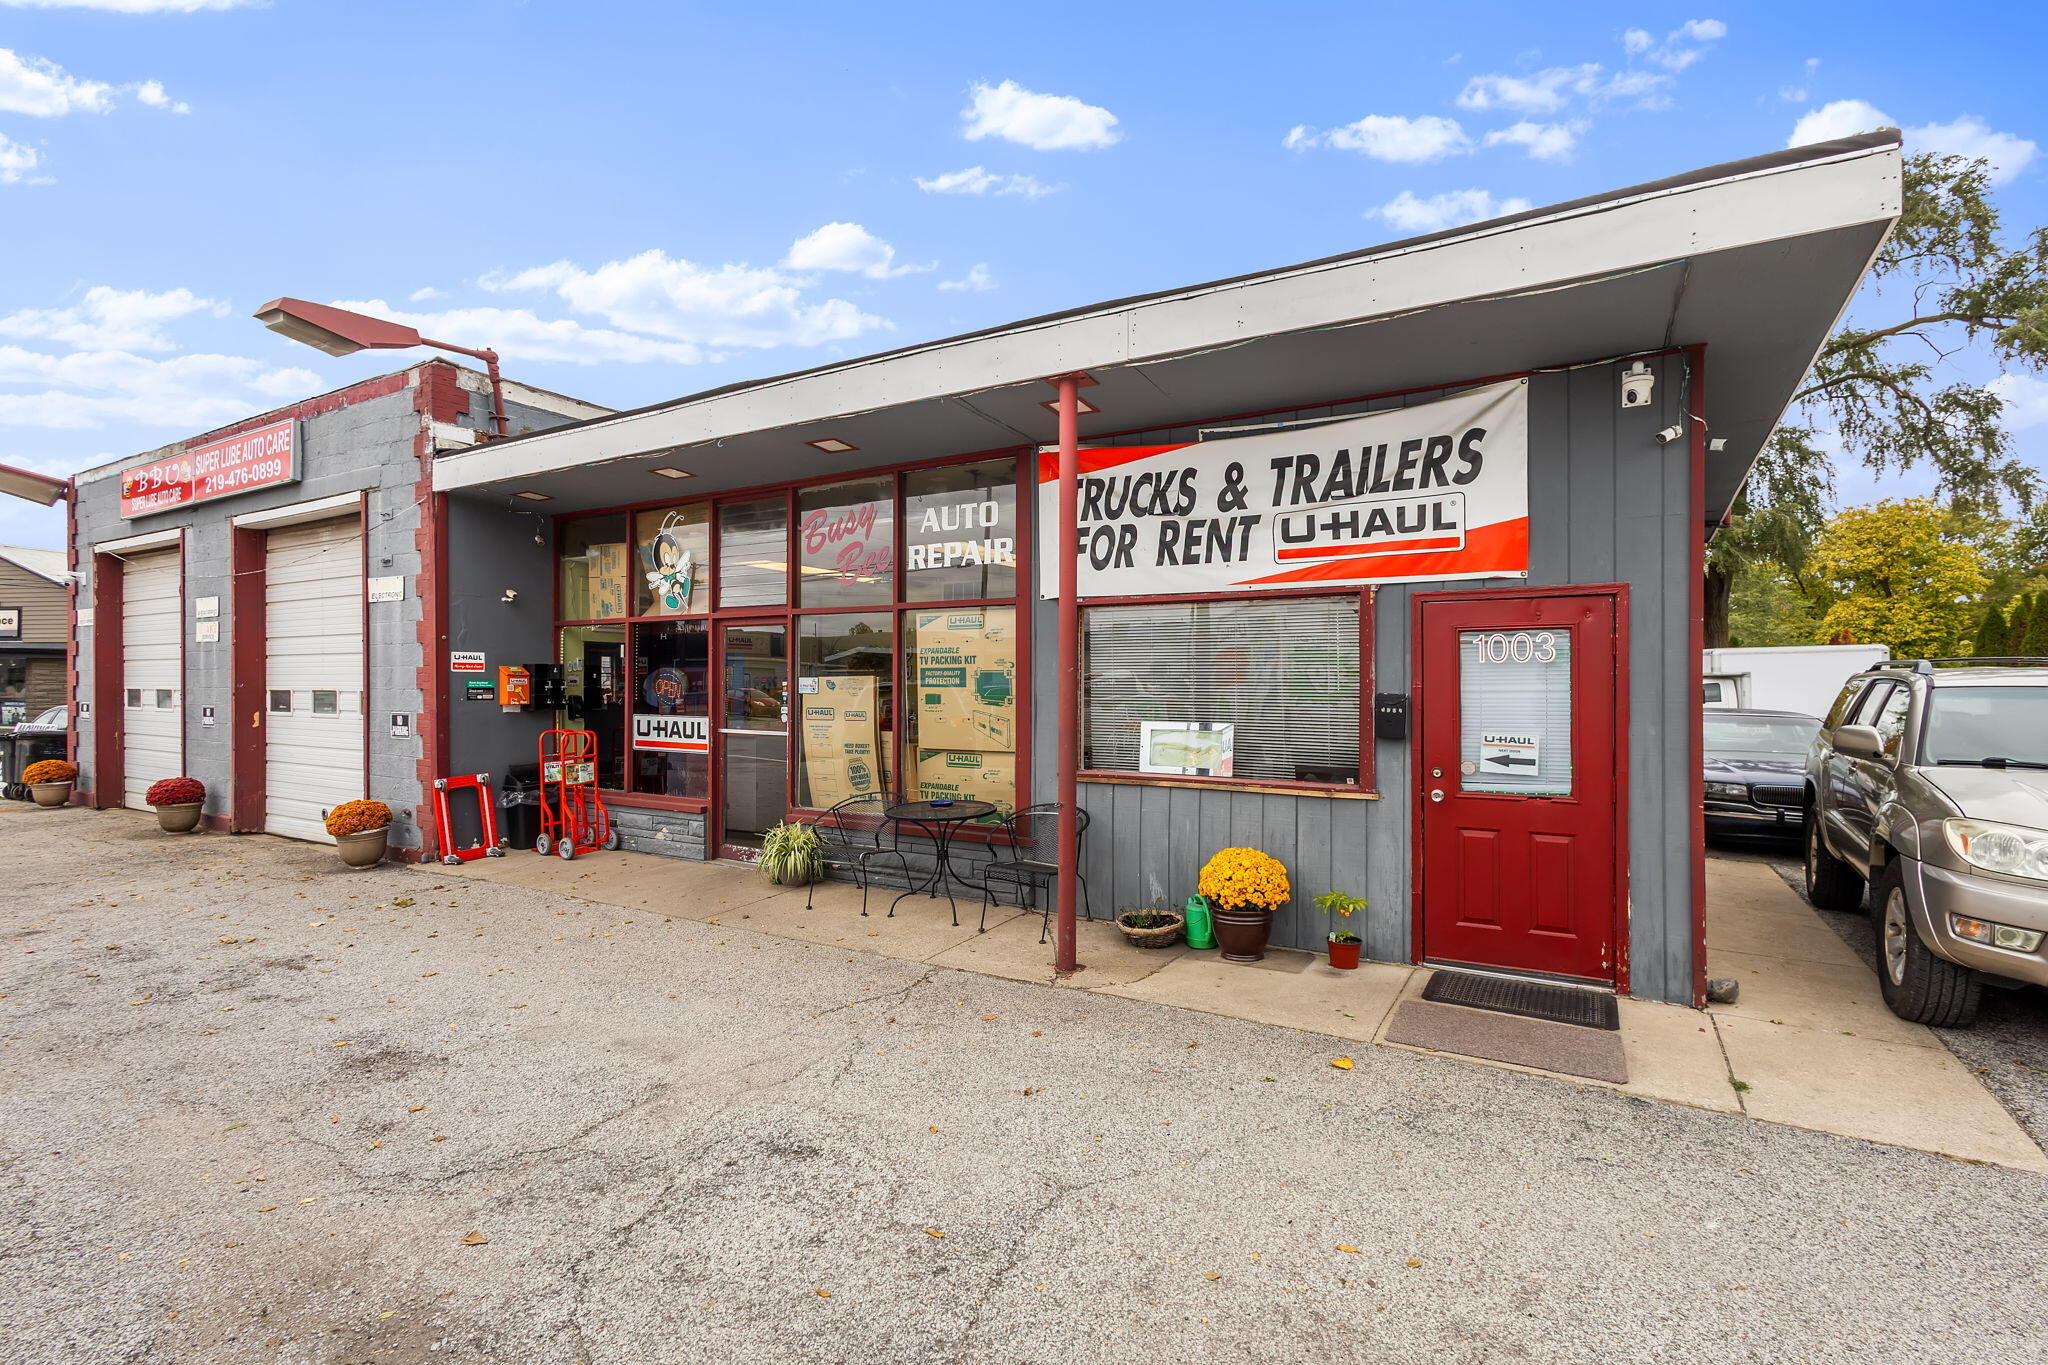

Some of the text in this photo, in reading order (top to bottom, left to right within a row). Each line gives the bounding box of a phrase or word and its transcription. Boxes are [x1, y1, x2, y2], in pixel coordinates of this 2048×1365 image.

[195, 429, 290, 476] SUPER LUBE AUTO CARE
[205, 459, 281, 494] 219-476-0899
[1217, 461, 1249, 512] &
[1270, 427, 1487, 507] TRAILERS
[920, 501, 999, 533] AUTO
[1281, 500, 1457, 544] U-HAUL
[801, 503, 878, 554] Busy
[1155, 514, 1262, 566] RENT
[908, 537, 1013, 569] REPAIR
[836, 541, 893, 586] Bee
[949, 616, 982, 624] U-HAUL
[920, 647, 960, 655] EXPANDABLE
[1472, 633, 1556, 663] 1003
[920, 655, 977, 665] TV PACKING KIT
[655, 679, 681, 699] OPEN
[925, 677, 960, 685] PROTECTION
[637, 720, 707, 740] U-HAUL
[1484, 736, 1535, 745] U-HAUL
[948, 754, 980, 763] U-HAUL
[849, 765, 867, 774] 100%
[920, 782, 959, 791] EXPANDABLE
[920, 790, 976, 801] TV PACKING KIT
